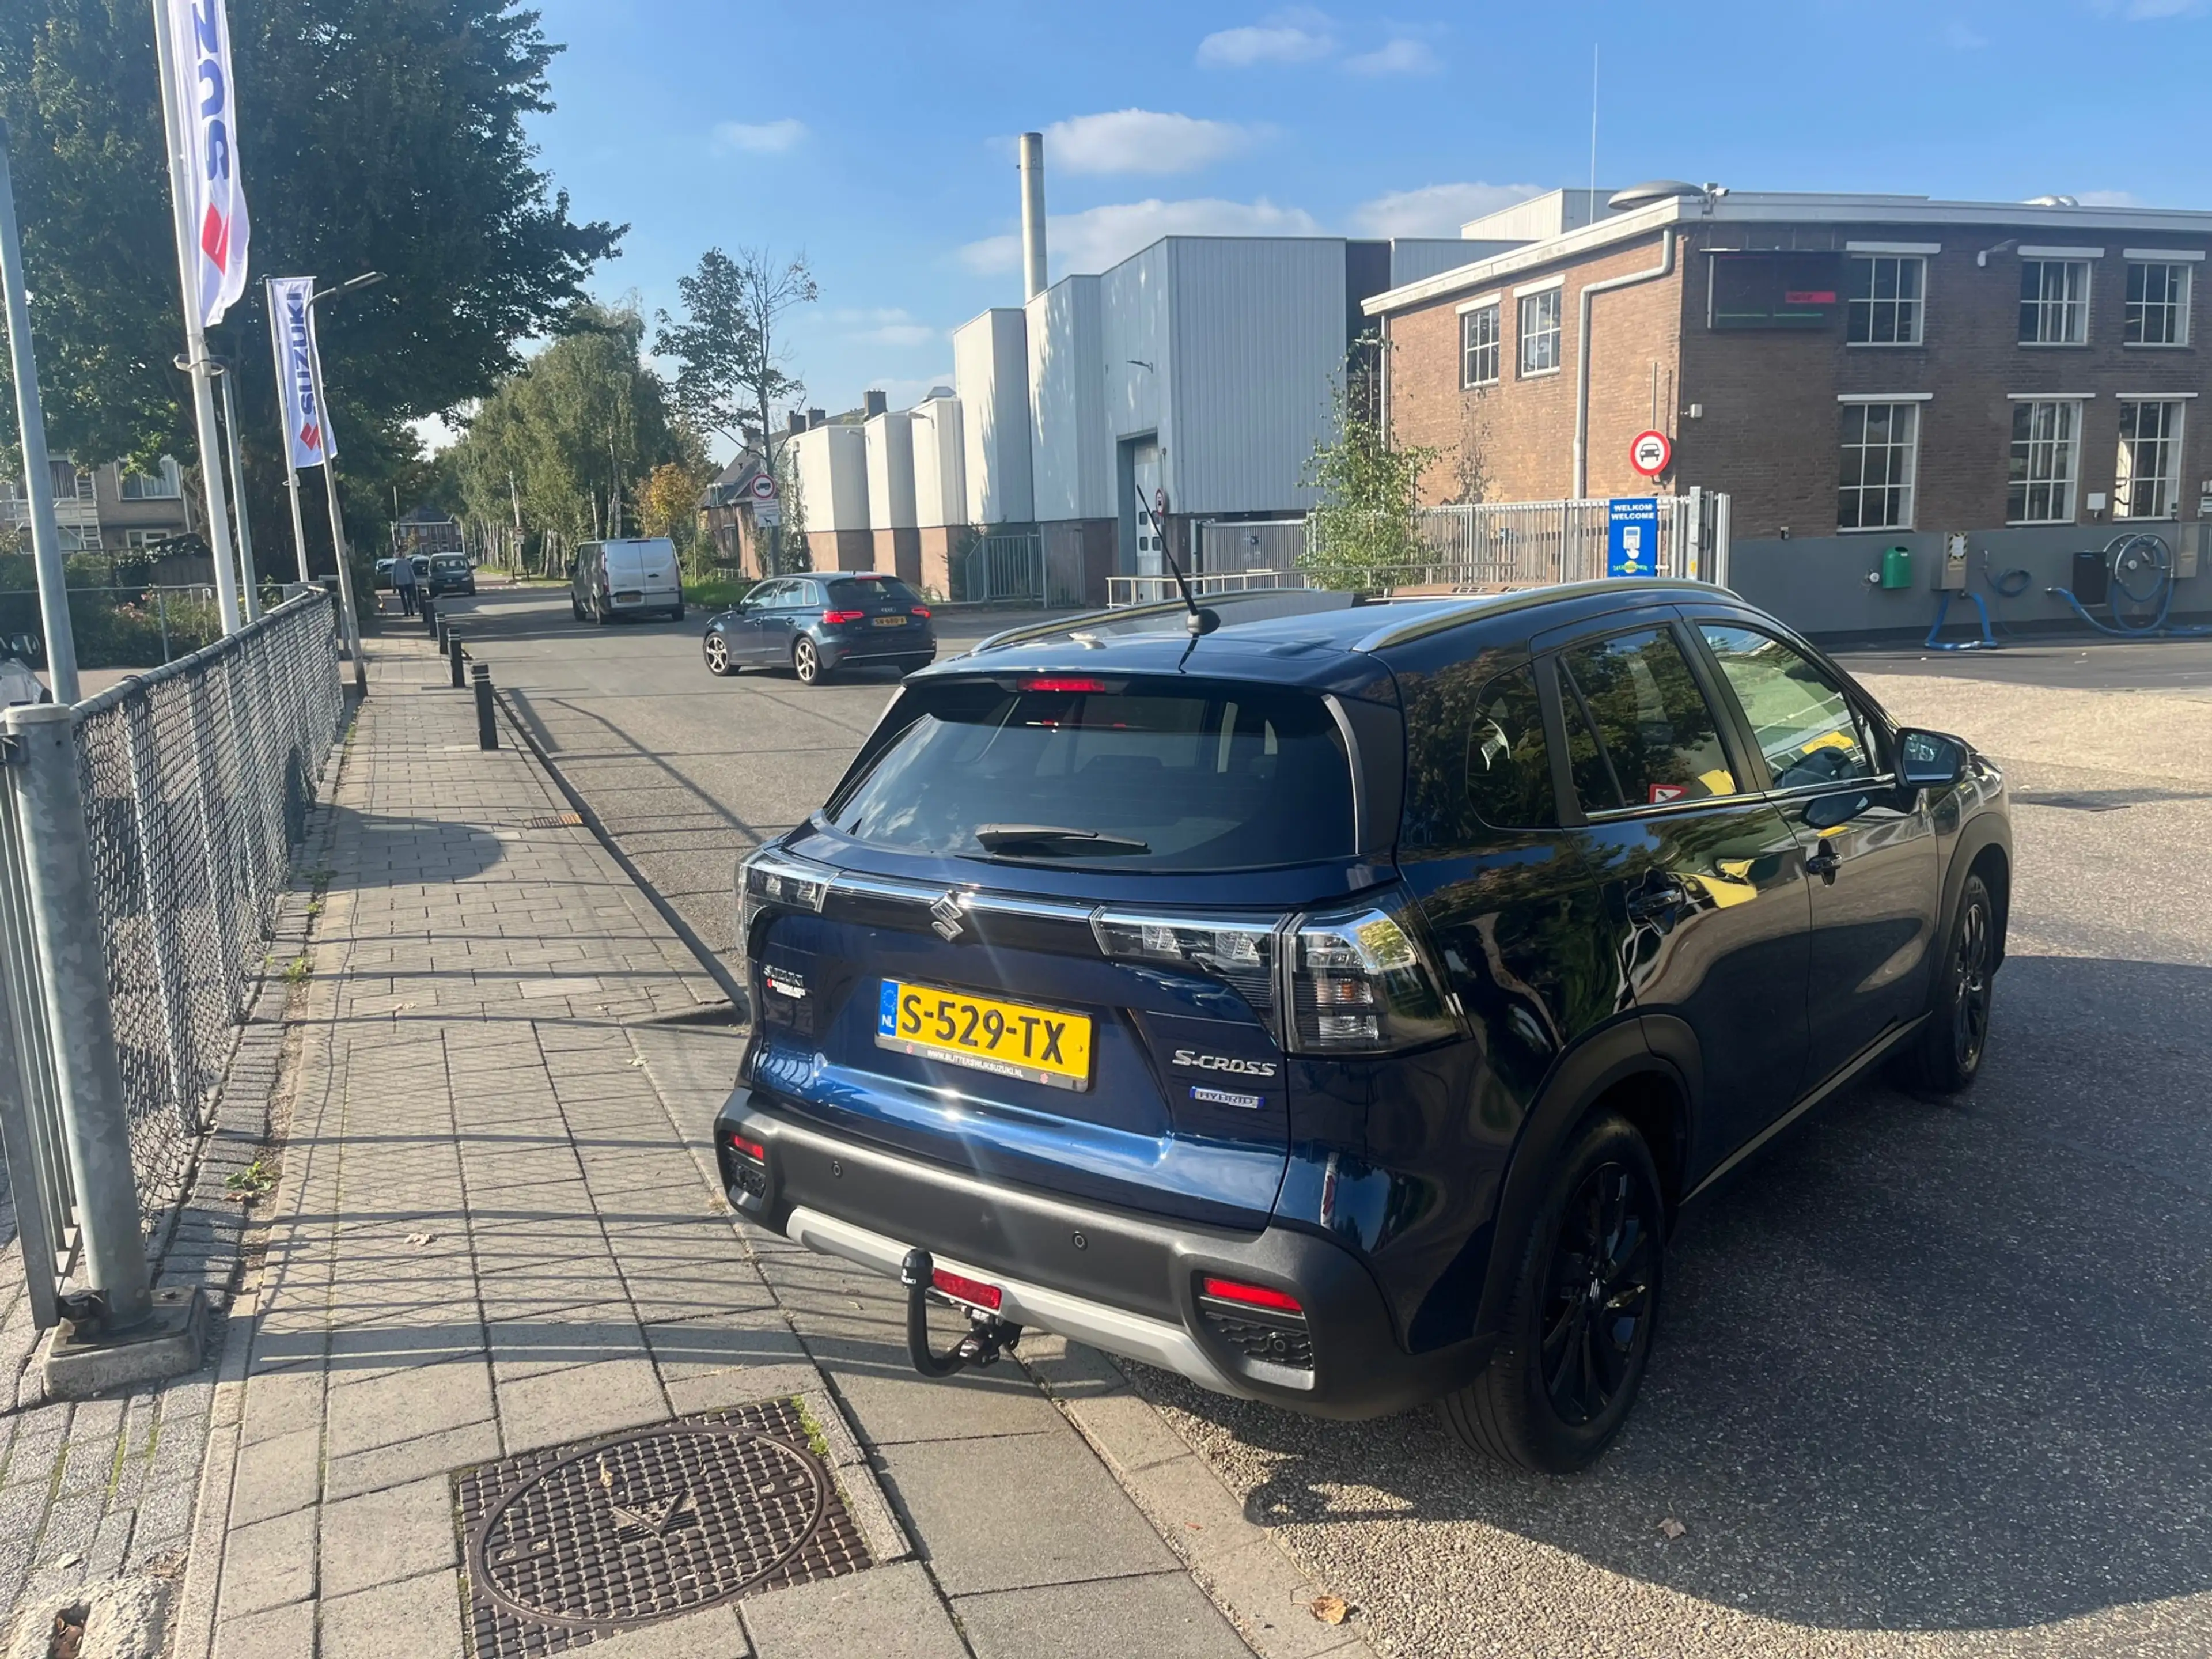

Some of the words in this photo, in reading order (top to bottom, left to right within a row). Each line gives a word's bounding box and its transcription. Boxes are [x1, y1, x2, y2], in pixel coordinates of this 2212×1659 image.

[287, 293, 316, 415] SUZUKI
[1613, 504, 1652, 512] WELKOM
[1611, 512, 1654, 520] WELCOME
[882, 1014, 895, 1028] NL
[902, 994, 1065, 1064] S-529-TX
[1172, 1050, 1277, 1077] S-CROSS
[1200, 1091, 1253, 1105] HYBRID
